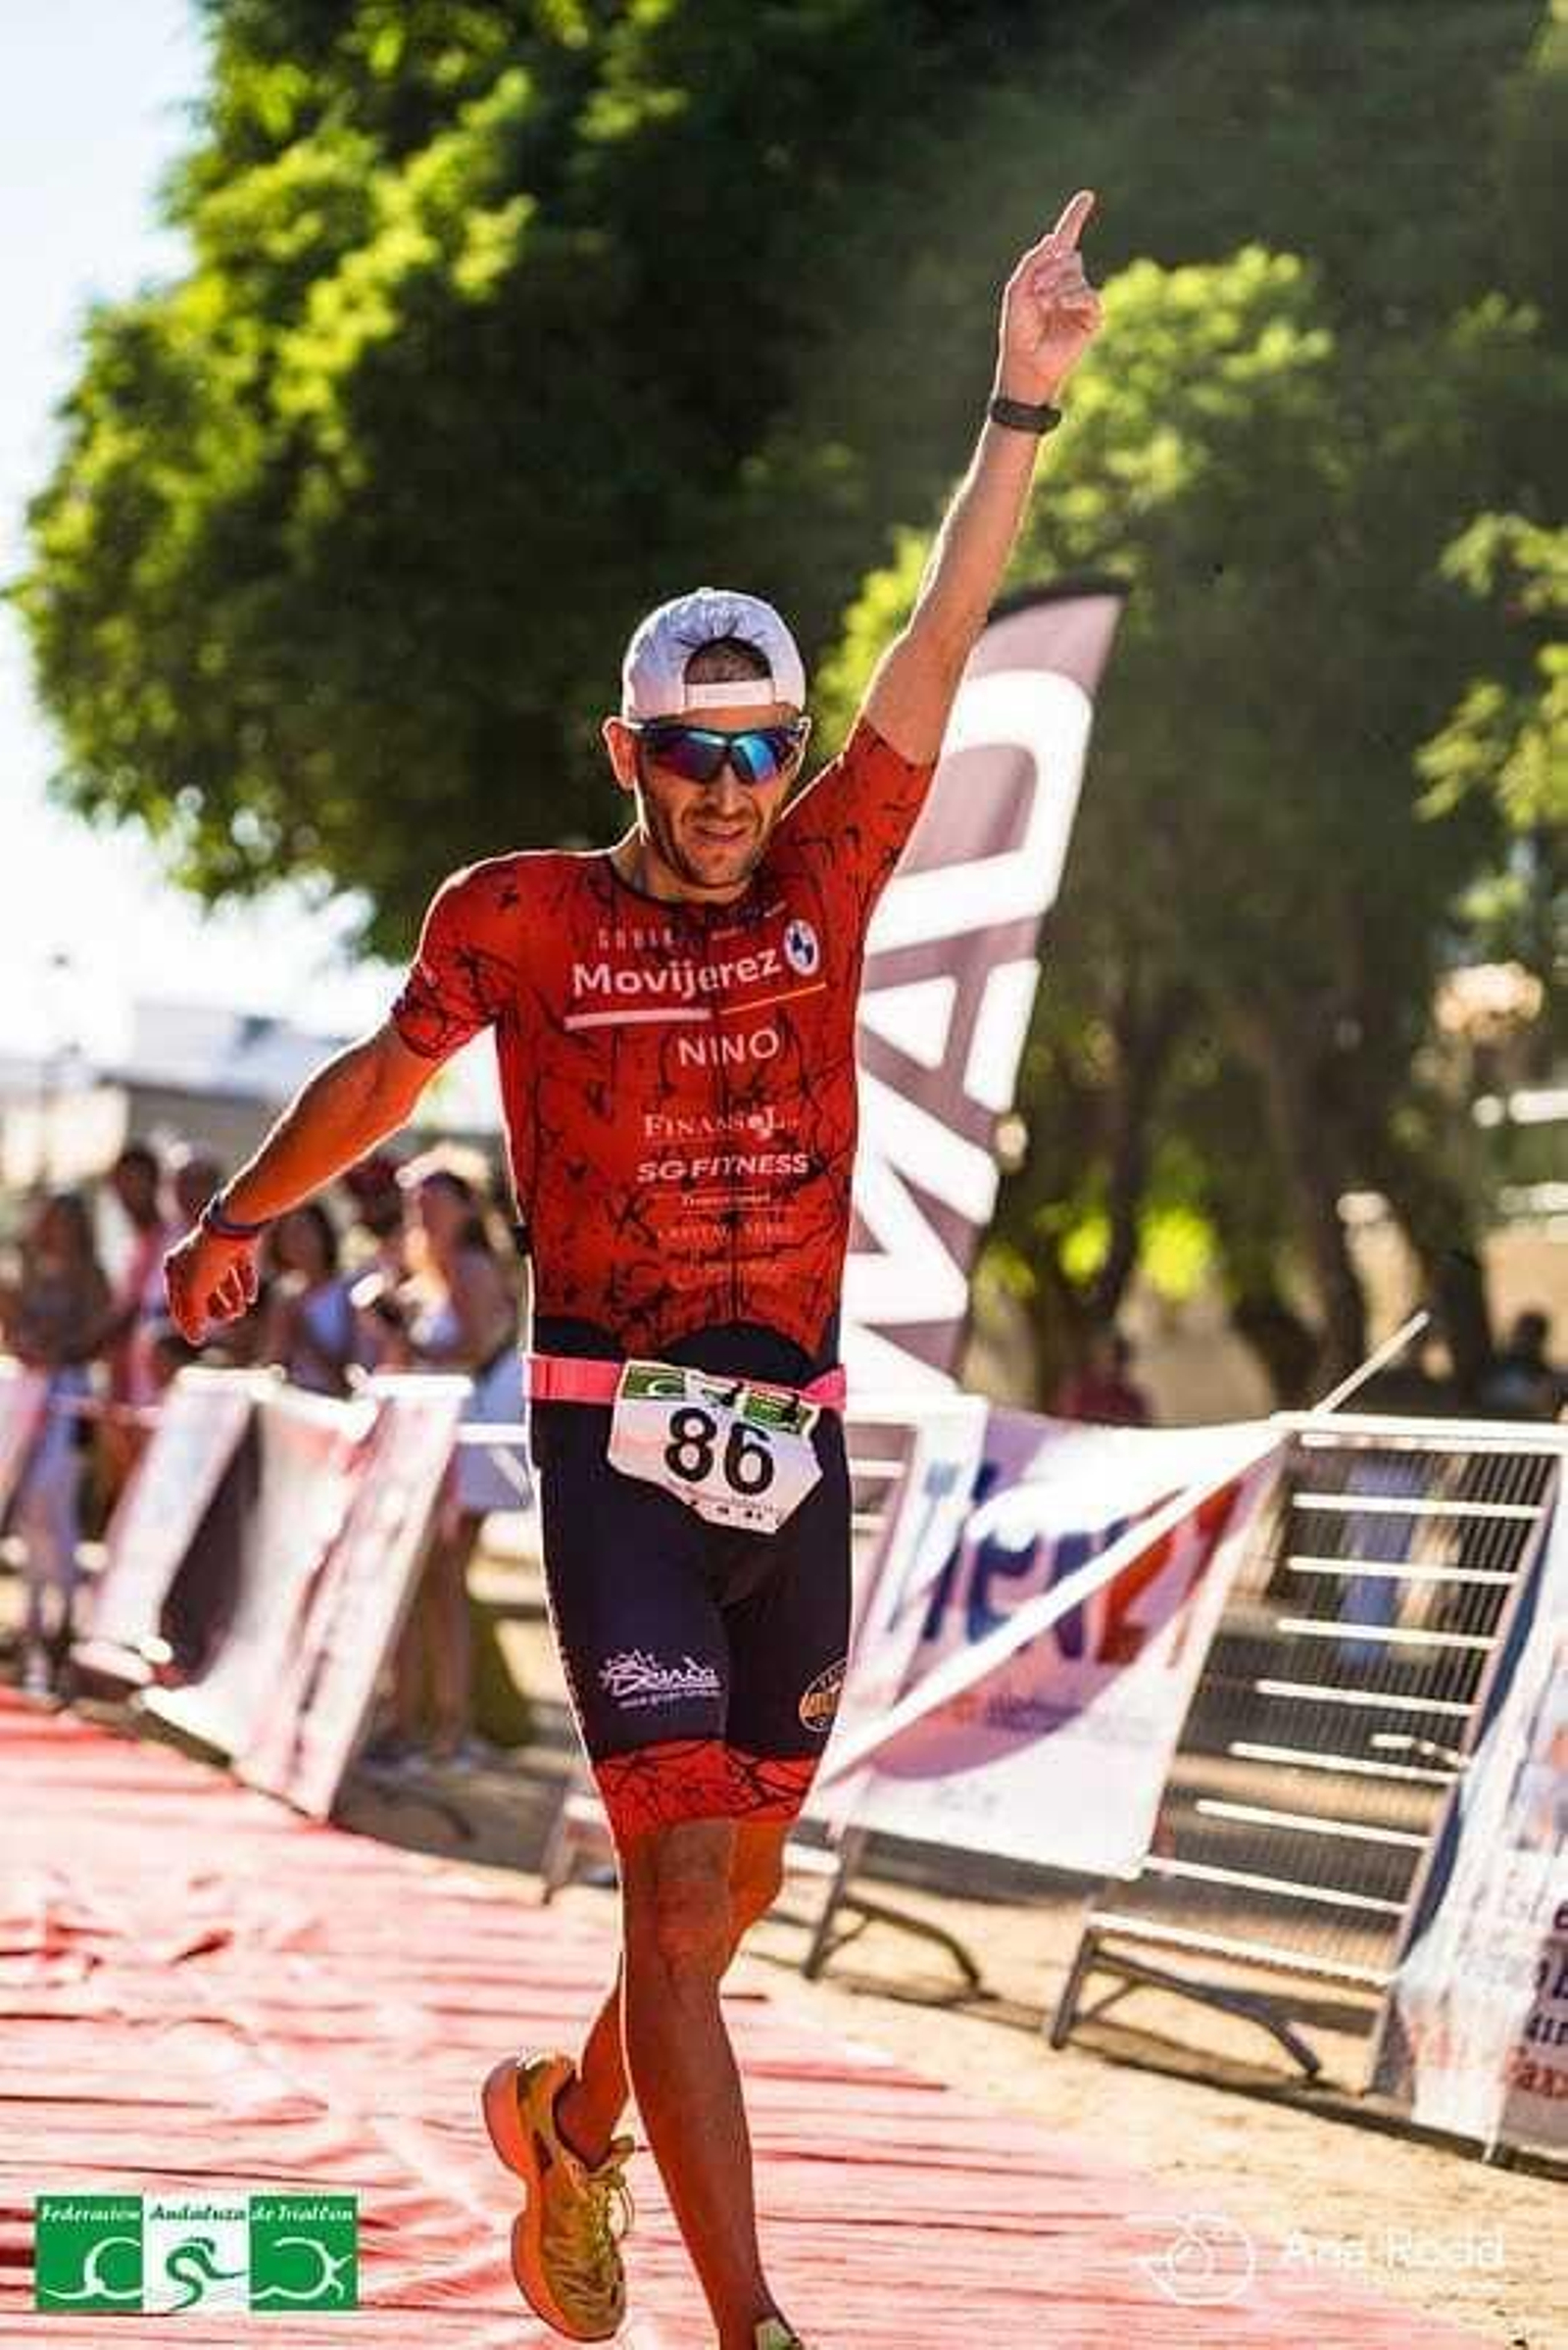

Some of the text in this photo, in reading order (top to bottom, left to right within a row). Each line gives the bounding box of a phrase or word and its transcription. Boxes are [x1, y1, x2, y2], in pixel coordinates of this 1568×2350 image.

[572, 948, 782, 1000] Movijerez
[677, 1028, 780, 1066] NINO
[637, 1153, 809, 1183] SG FITNESS
[664, 1408, 774, 1495] 86
